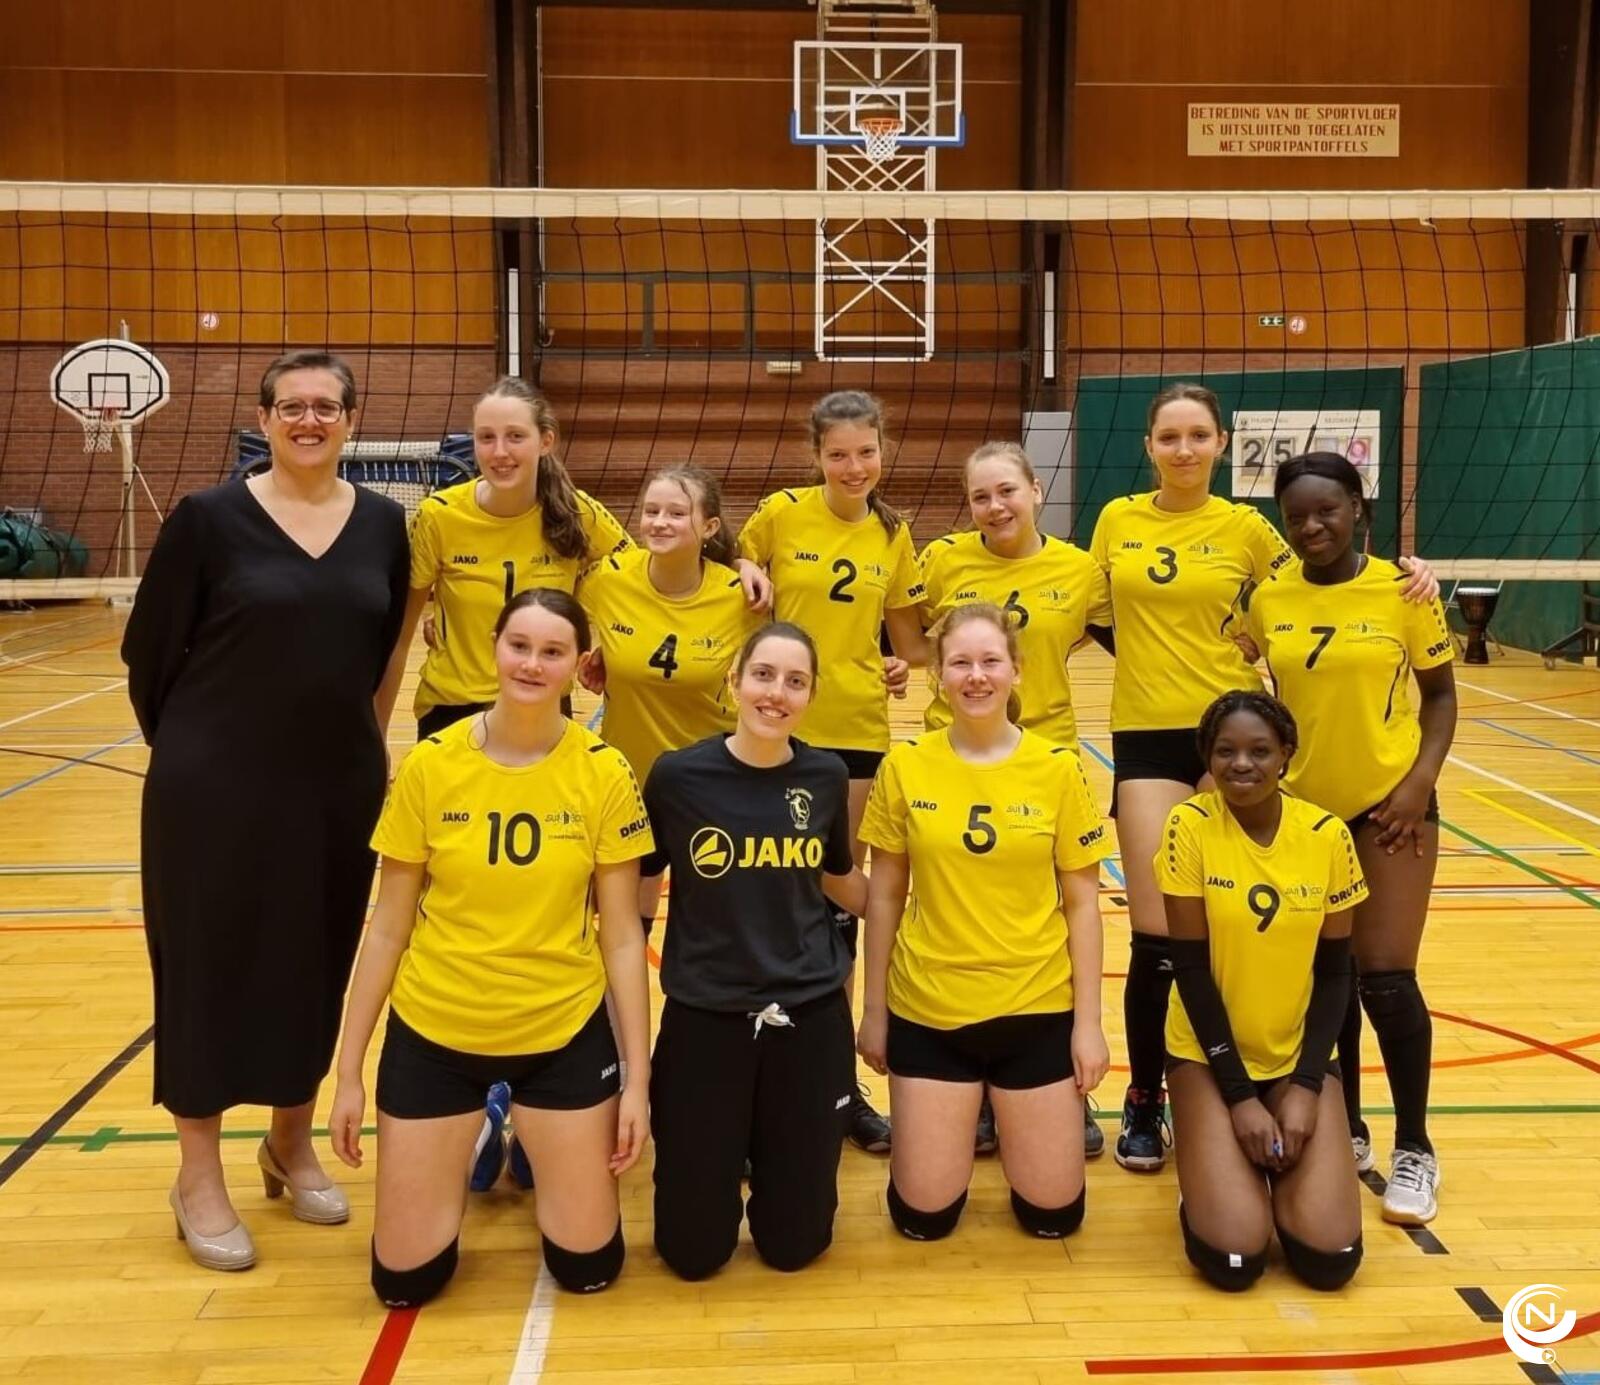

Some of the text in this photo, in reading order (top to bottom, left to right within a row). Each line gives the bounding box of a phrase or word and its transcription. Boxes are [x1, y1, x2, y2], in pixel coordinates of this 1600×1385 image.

[1191, 107, 1397, 120] BETREDING VAN DE SPORTVLOER
[1202, 124, 1386, 136] IS UITSLUITEND TOEGELATEN
[1219, 141, 1368, 153] MET SPORTPANTOFFELS
[1243, 439, 1291, 467] 25
[1122, 541, 1143, 550] JAKO
[453, 555, 478, 565] JAKO
[794, 551, 819, 562] JAKO
[1147, 546, 1178, 584] 3
[502, 561, 515, 601] 1
[829, 558, 858, 603] 2
[956, 591, 977, 600] JAKO
[1003, 590, 1030, 629] 6
[610, 622, 634, 636] JAKO
[1274, 623, 1294, 632] JAKO
[1305, 626, 1336, 669] 7
[648, 634, 678, 679] 4
[911, 799, 937, 811] JAKO
[441, 812, 469, 823] JAKO
[962, 805, 997, 854] 5
[486, 811, 542, 866] 10
[738, 837, 823, 868] JAKO
[1206, 876, 1235, 889] JAKO
[1247, 884, 1281, 933] 9
